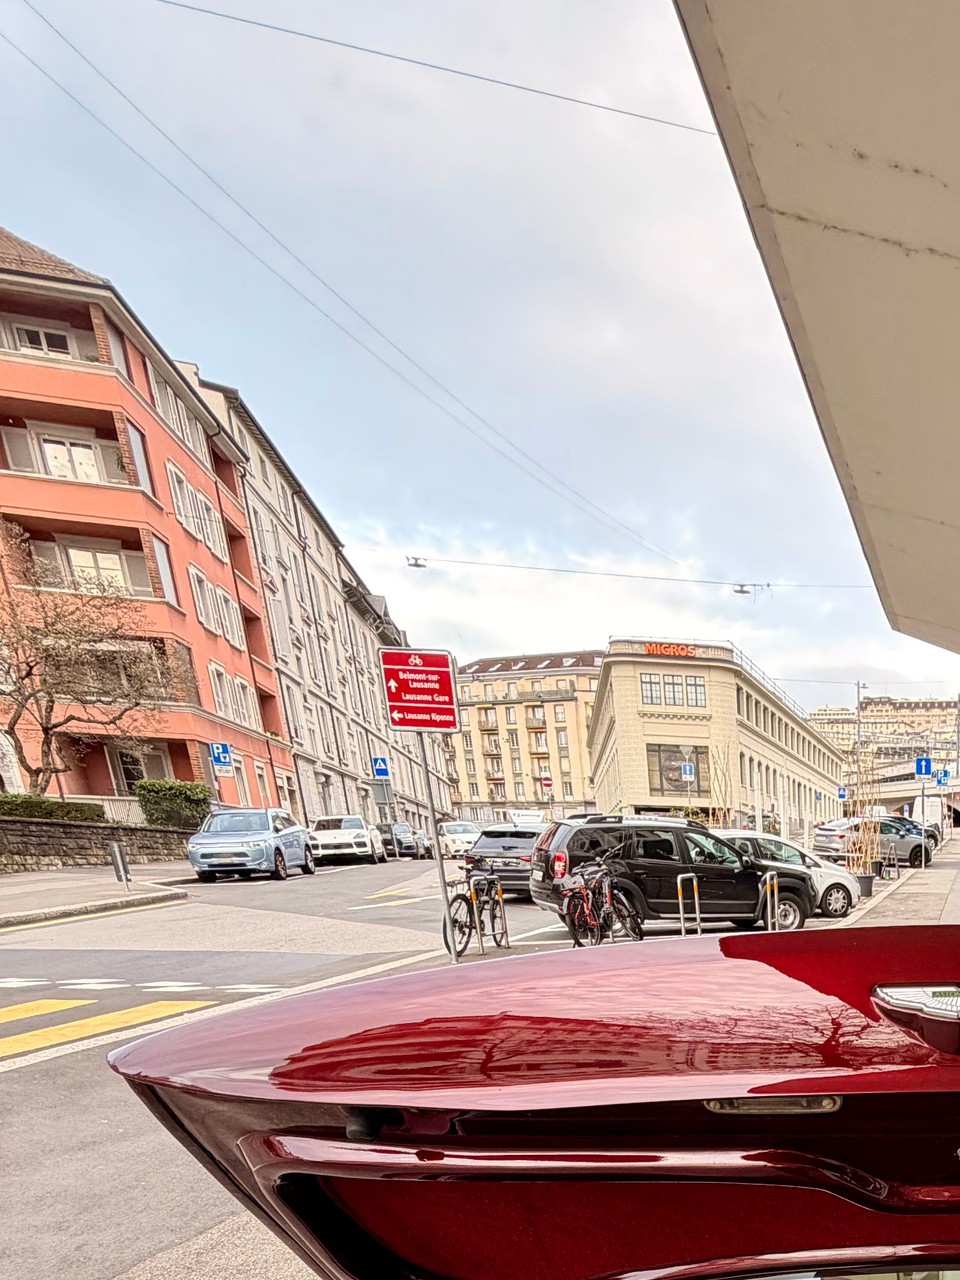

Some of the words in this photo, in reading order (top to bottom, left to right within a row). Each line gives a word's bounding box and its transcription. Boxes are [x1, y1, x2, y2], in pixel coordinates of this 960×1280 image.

[644, 642, 696, 657] MIGROS
[398, 671, 440, 681] Belmont-sur-
[409, 680, 440, 689] Lausanne
[401, 692, 432, 701] Lausanne
[433, 693, 449, 702] Gare
[404, 711, 430, 720] Lausanne
[431, 712, 454, 722] Riponne
[212, 743, 223, 757] P
